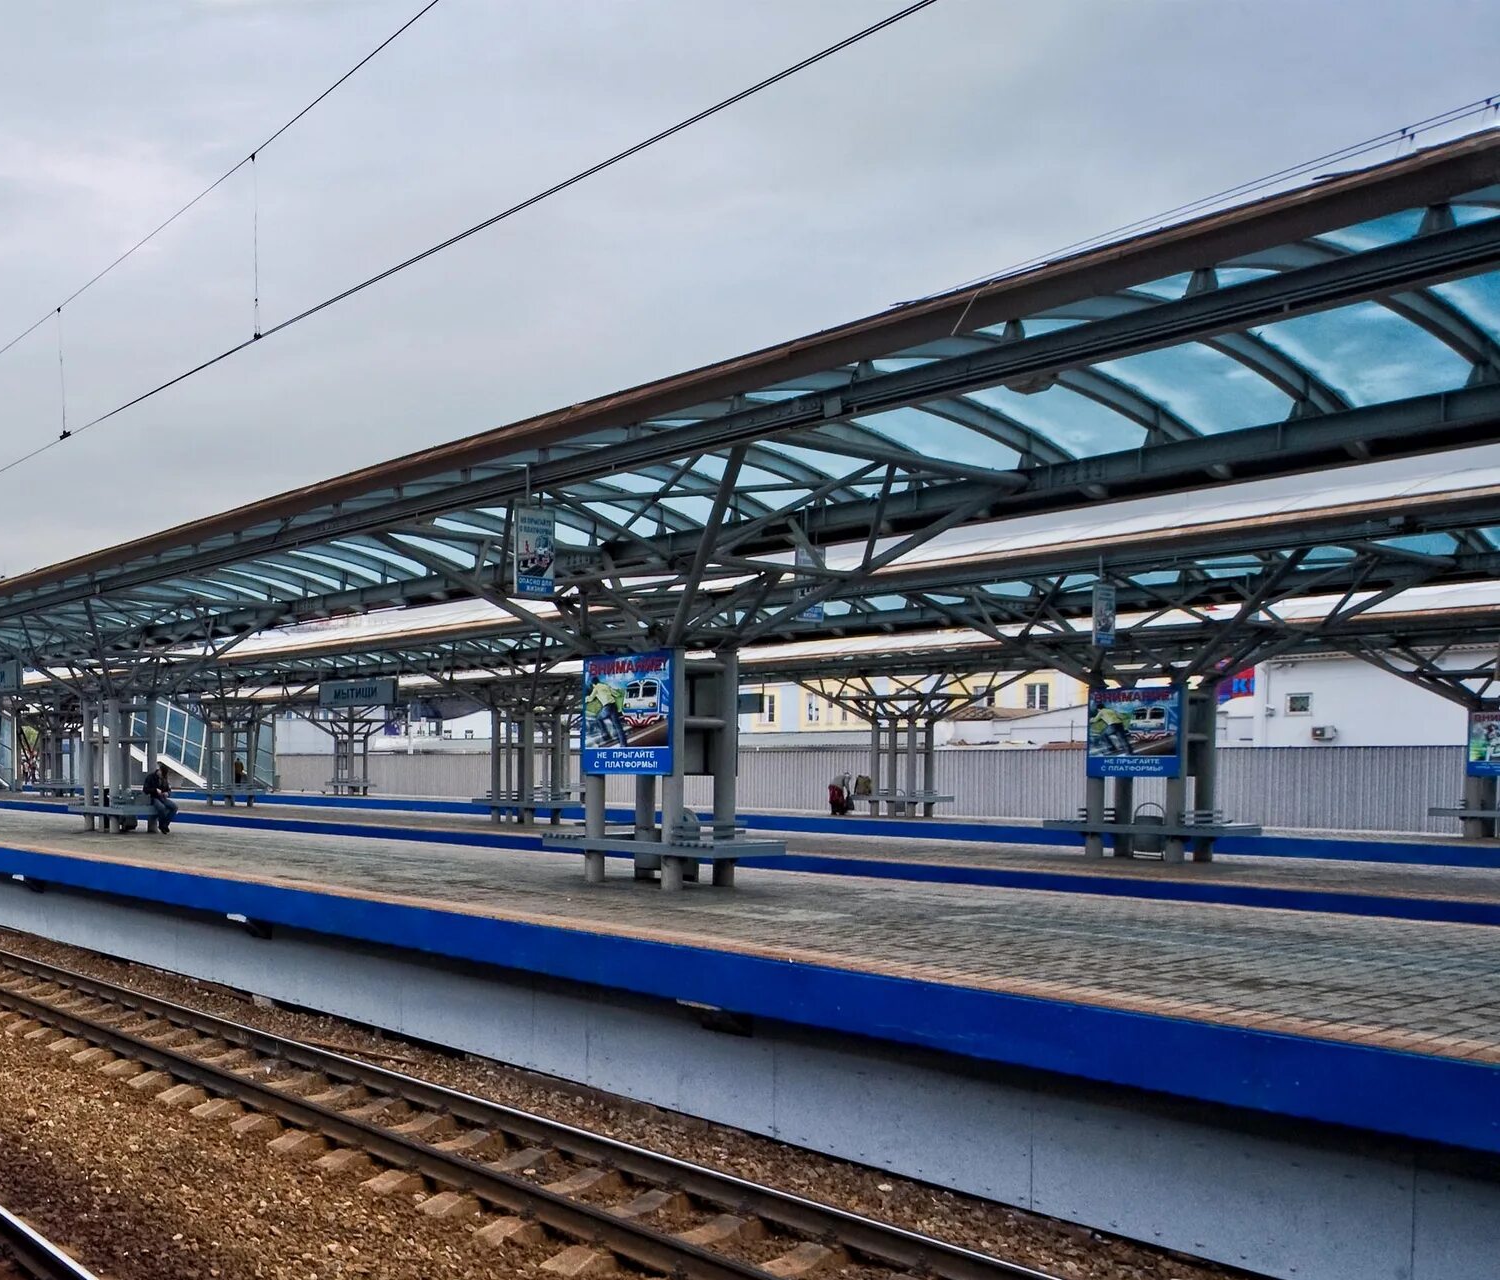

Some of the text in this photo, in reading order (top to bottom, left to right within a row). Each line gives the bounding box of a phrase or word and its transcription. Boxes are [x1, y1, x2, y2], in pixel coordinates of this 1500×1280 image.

[519, 577, 541, 585] ОПАСНО
[333, 686, 377, 699] МЫТИЩИ
[596, 750, 655, 759] НЕ ПРЫГАЙТЕ
[594, 760, 658, 769] С ПЛАТФОРМЫ!
